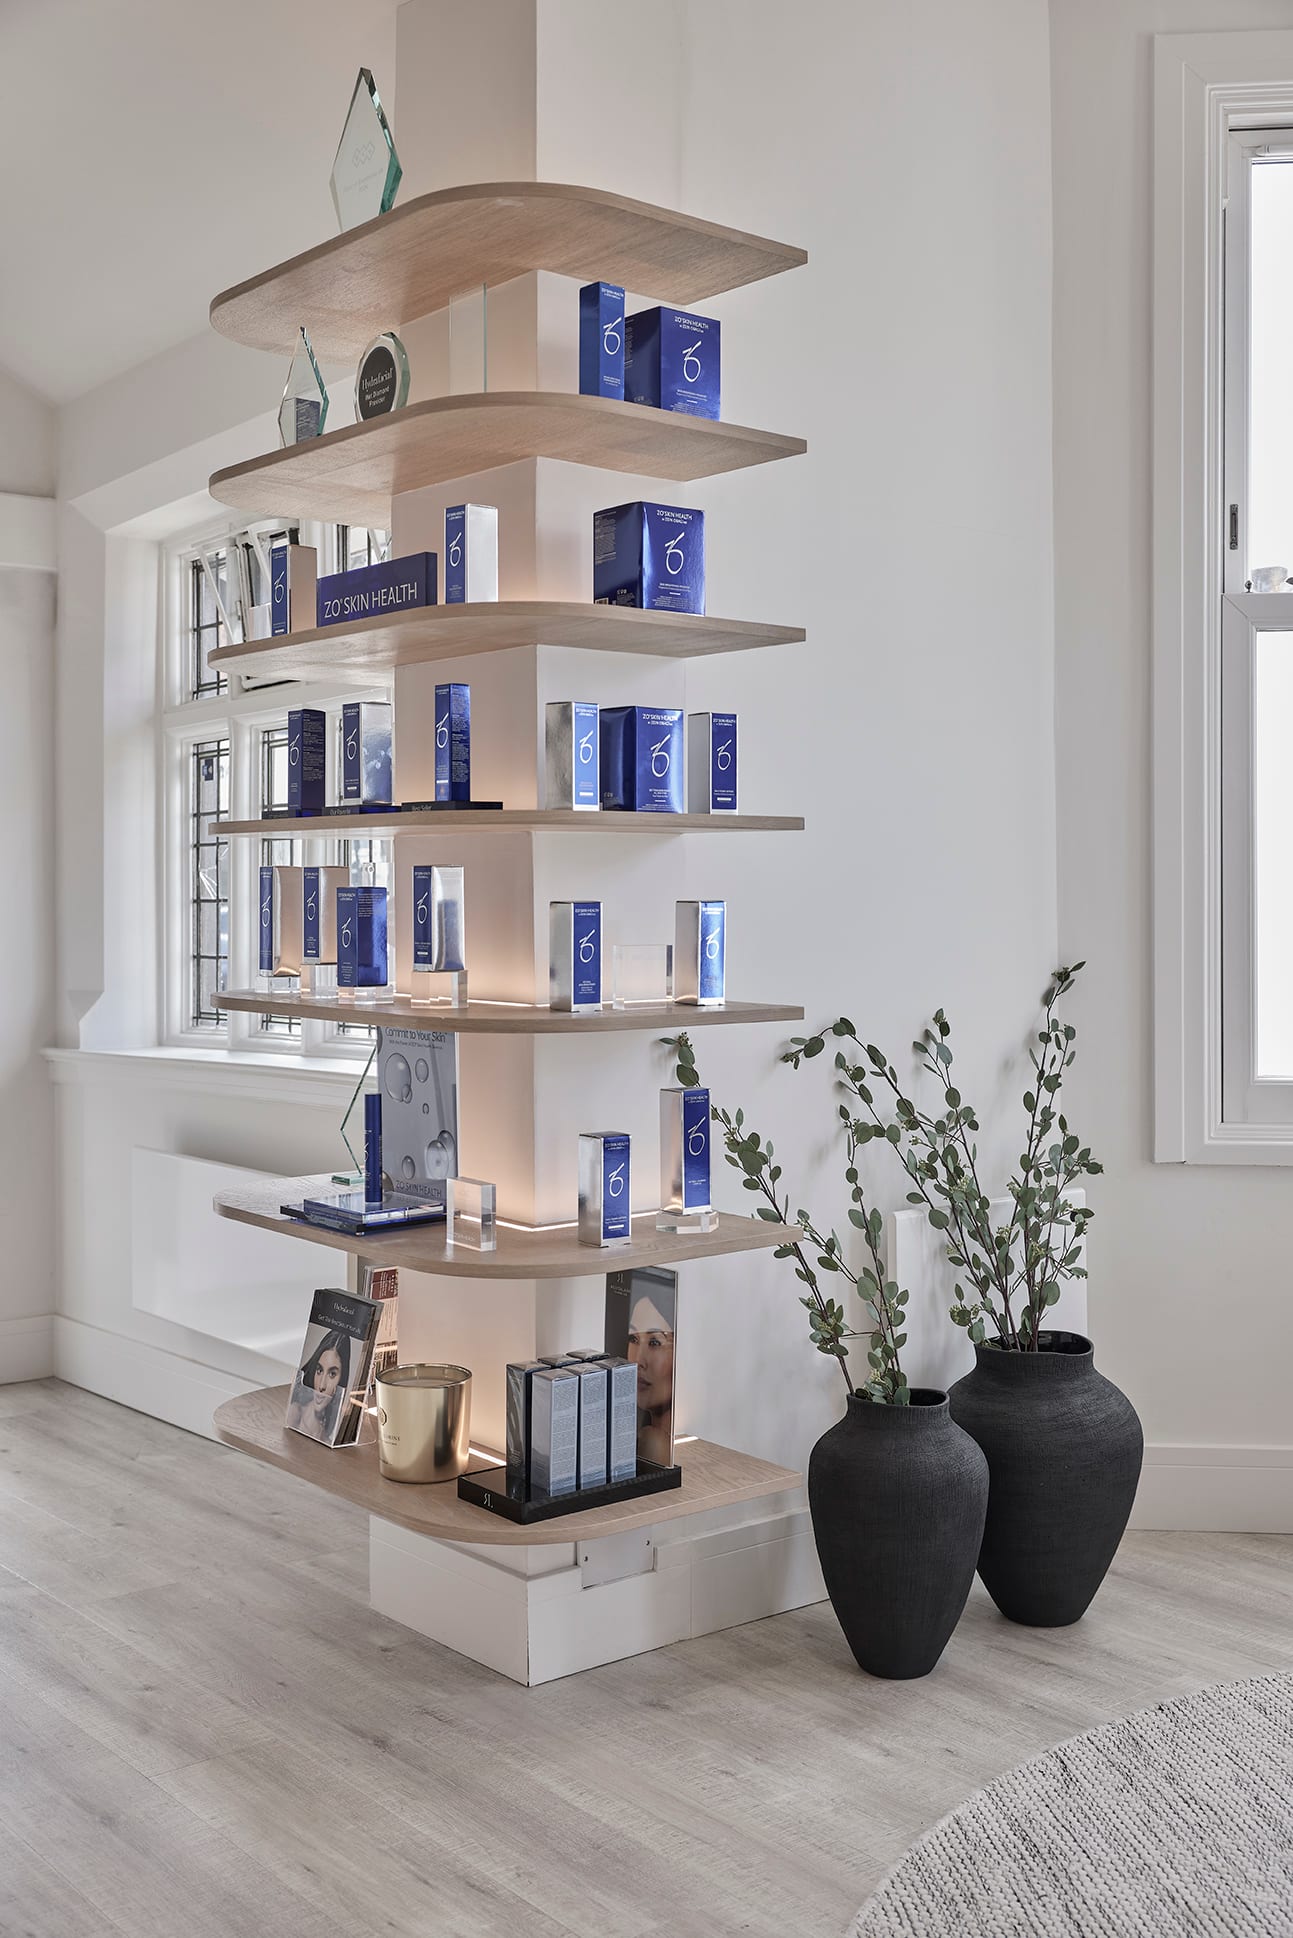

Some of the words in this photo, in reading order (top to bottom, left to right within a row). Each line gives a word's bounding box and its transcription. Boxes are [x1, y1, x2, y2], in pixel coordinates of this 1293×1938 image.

[343, 593, 369, 614] SKIN
[371, 582, 417, 608] HEALTH
[416, 1030, 431, 1041] Your
[418, 1185, 442, 1199] HEALTH
